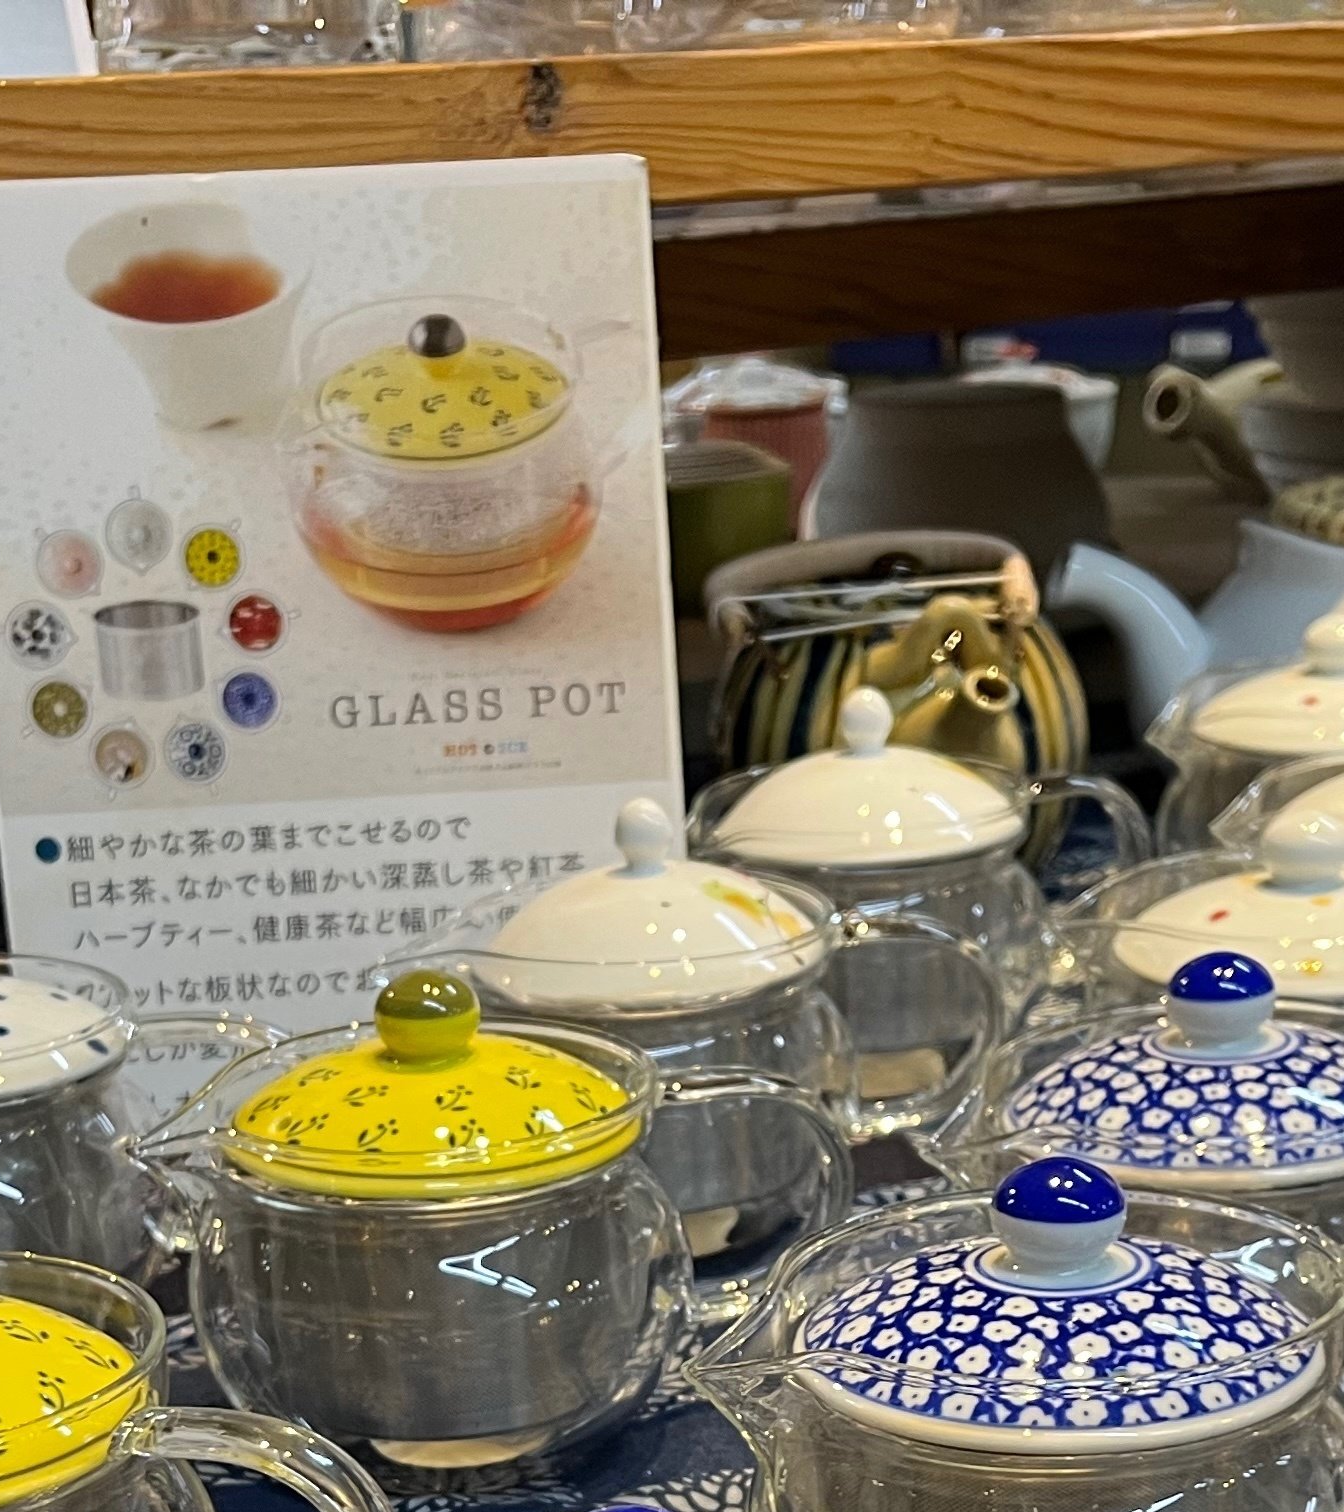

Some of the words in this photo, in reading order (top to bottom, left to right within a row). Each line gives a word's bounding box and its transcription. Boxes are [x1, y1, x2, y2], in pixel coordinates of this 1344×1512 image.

[329, 687, 504, 729] GLASS
[528, 681, 626, 718] POT
[67, 816, 472, 863] 細やかな茶の葉までこせるので
